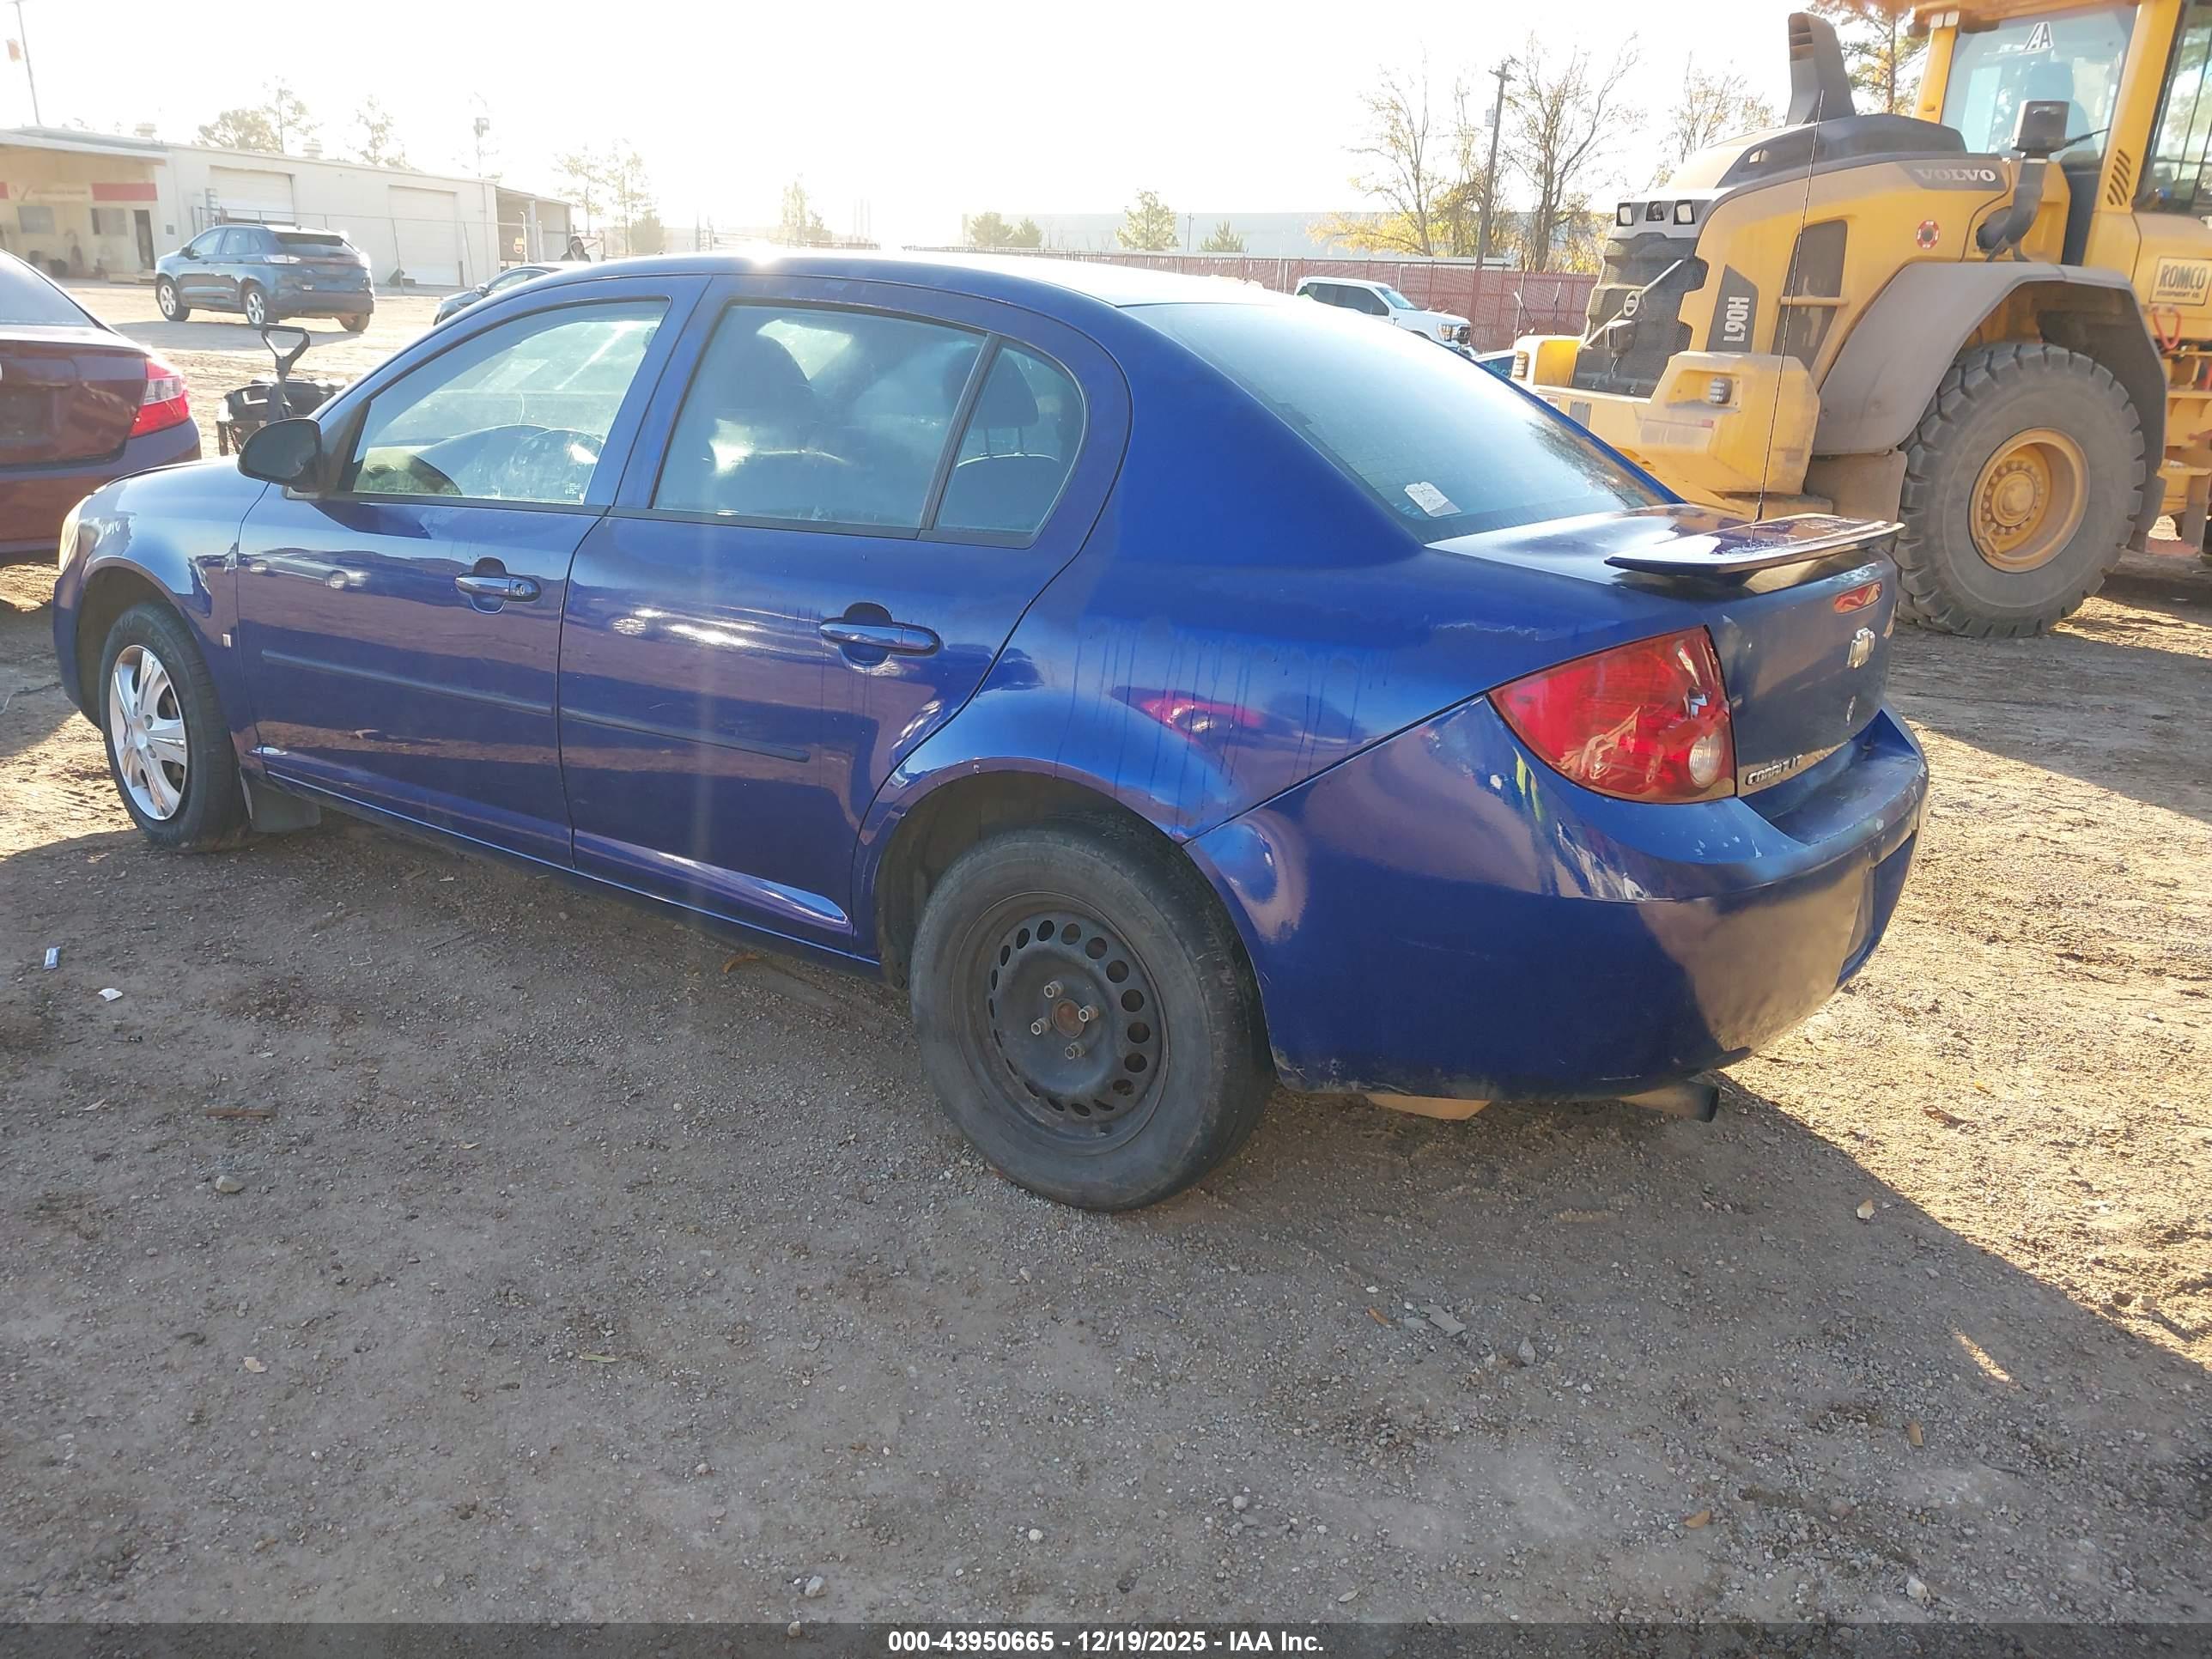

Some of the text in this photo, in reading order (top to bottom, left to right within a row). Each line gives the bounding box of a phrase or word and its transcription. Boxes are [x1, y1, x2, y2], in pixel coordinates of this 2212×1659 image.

[1914, 168, 1996, 182] VOLVO
[2158, 264, 2207, 289] ROMCO
[1723, 296, 1750, 342] L90H
